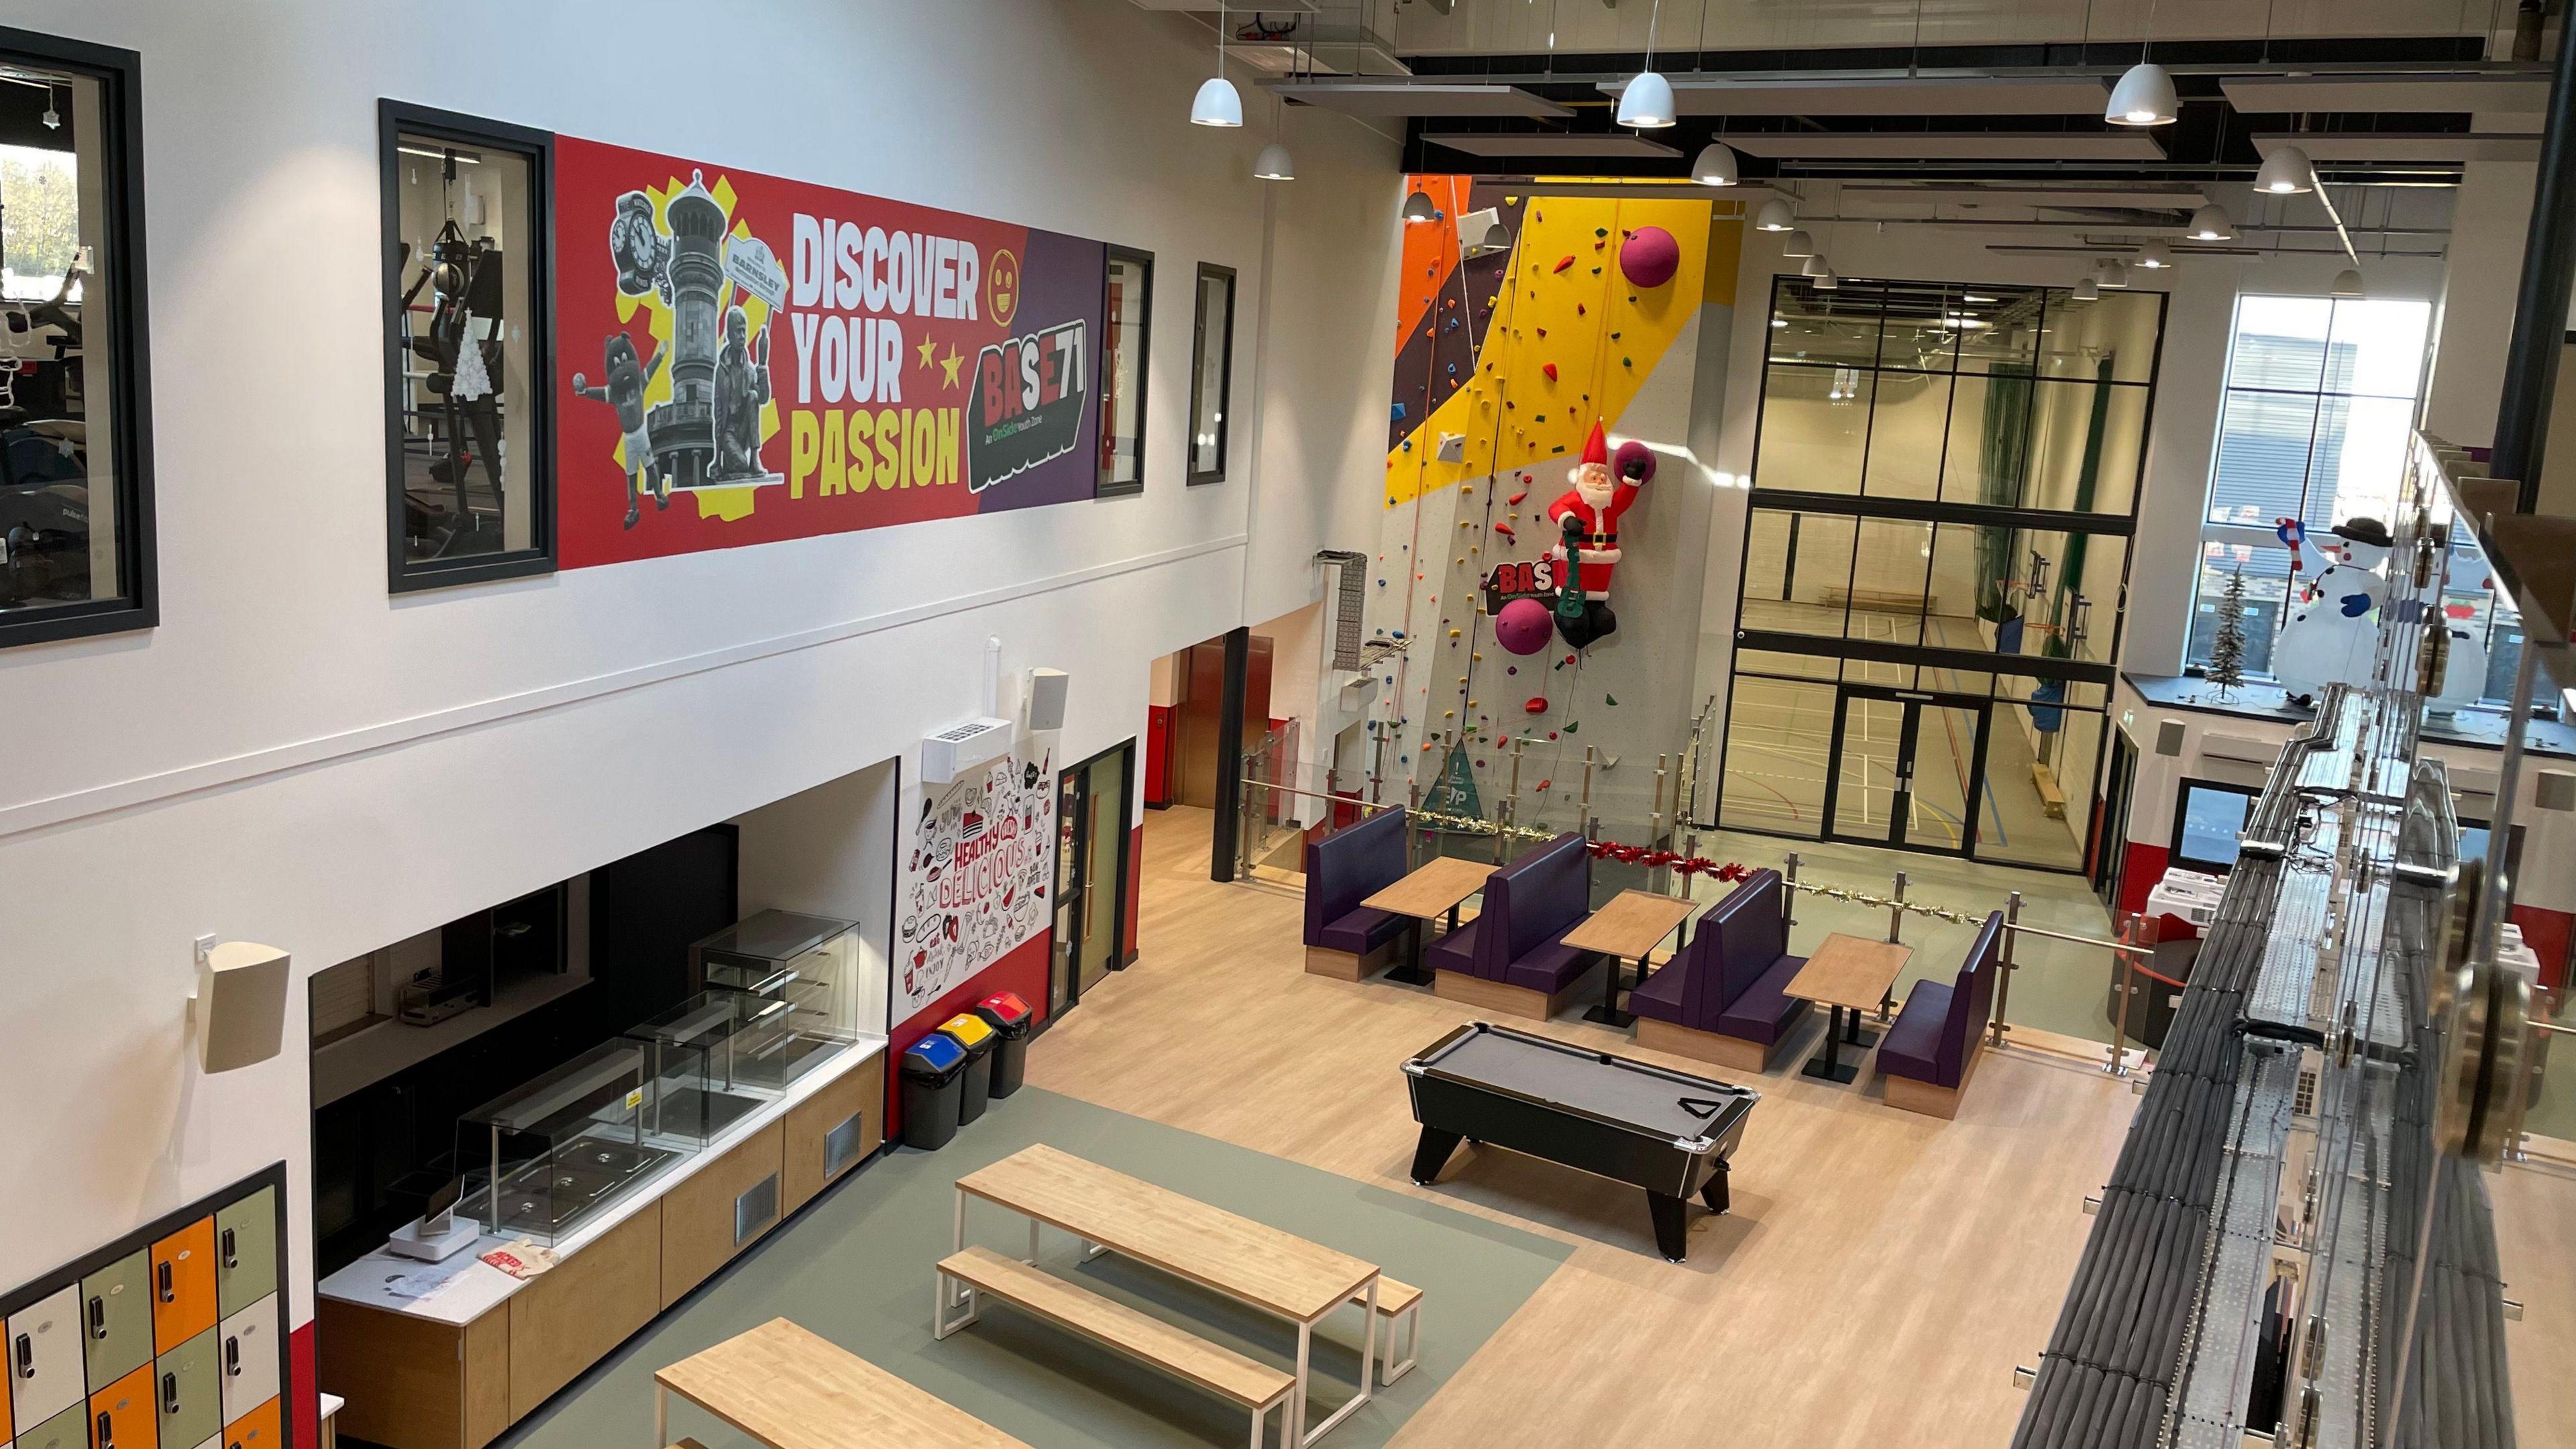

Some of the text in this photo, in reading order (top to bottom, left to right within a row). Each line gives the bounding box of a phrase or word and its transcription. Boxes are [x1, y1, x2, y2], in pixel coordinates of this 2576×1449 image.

[733, 254, 780, 291] BARNSLEY
[793, 213, 979, 321] DISCOVER
[791, 313, 903, 403] YOUR
[983, 326, 1084, 427] BASE71
[791, 408, 960, 499] PASSION
[985, 415, 1042, 445] An OnSide Youth Zone
[1499, 562, 1555, 594] BAS
[939, 837, 1025, 908] DELICIOUS
[954, 822, 1000, 871] HEALTHY
